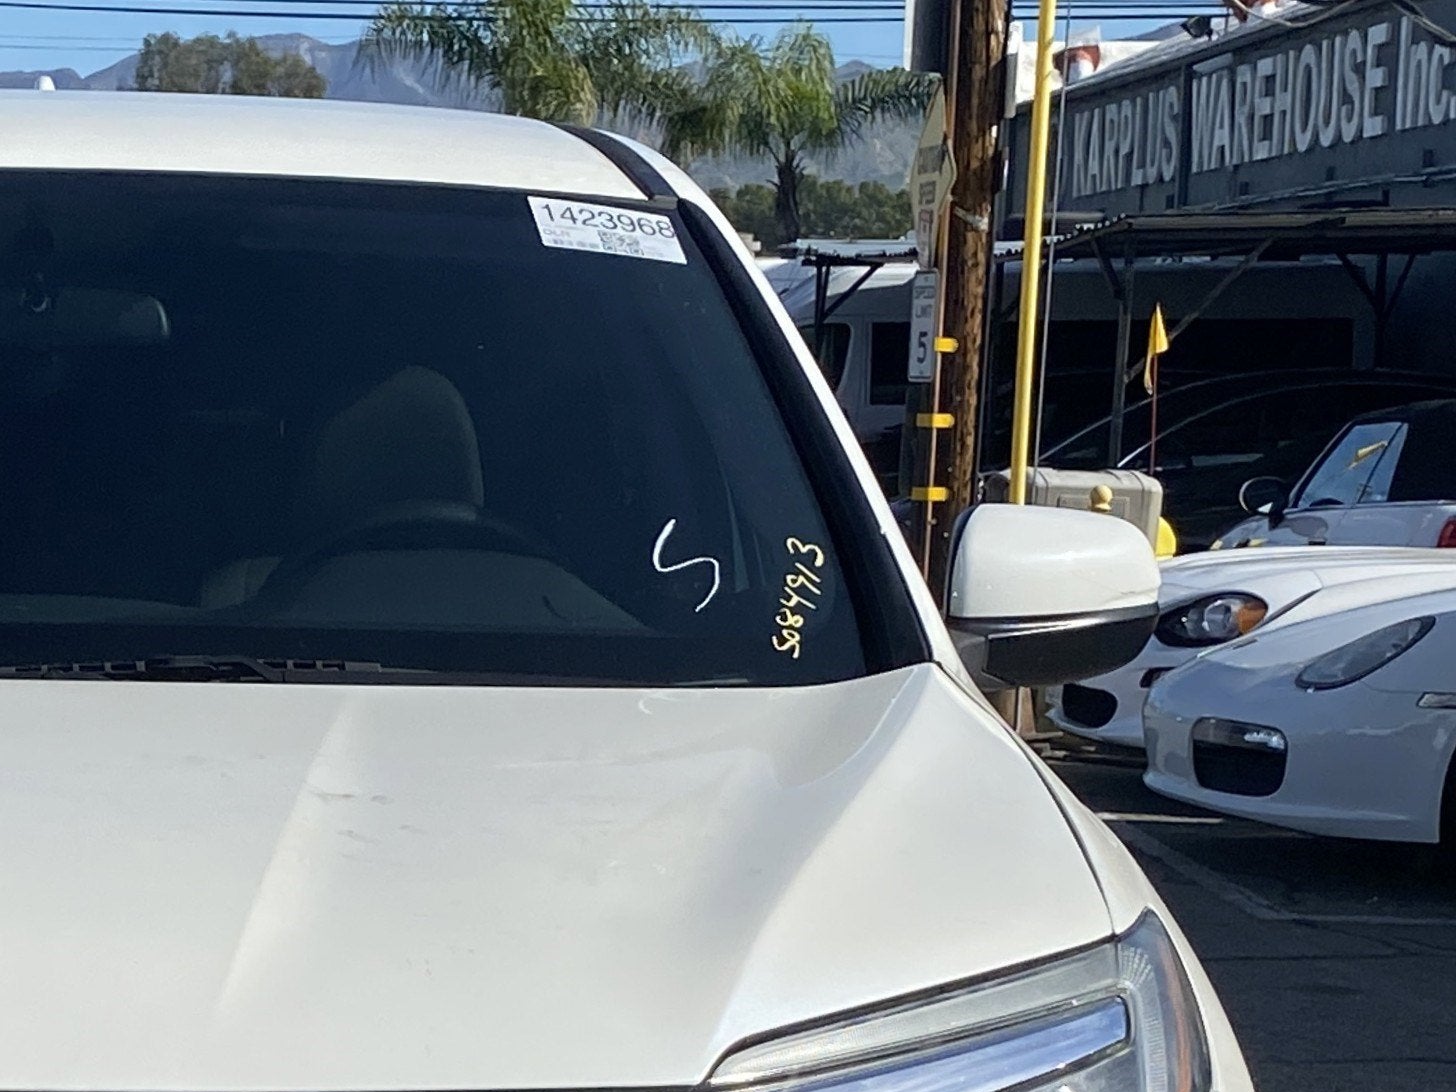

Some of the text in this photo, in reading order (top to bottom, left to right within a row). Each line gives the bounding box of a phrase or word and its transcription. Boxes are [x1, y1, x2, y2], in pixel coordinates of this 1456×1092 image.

[1073, 86, 1179, 198] KARPLUS
[1191, 23, 1392, 173] WAREHOUSE
[541, 203, 676, 239] 1423968
[917, 331, 928, 364] 5
